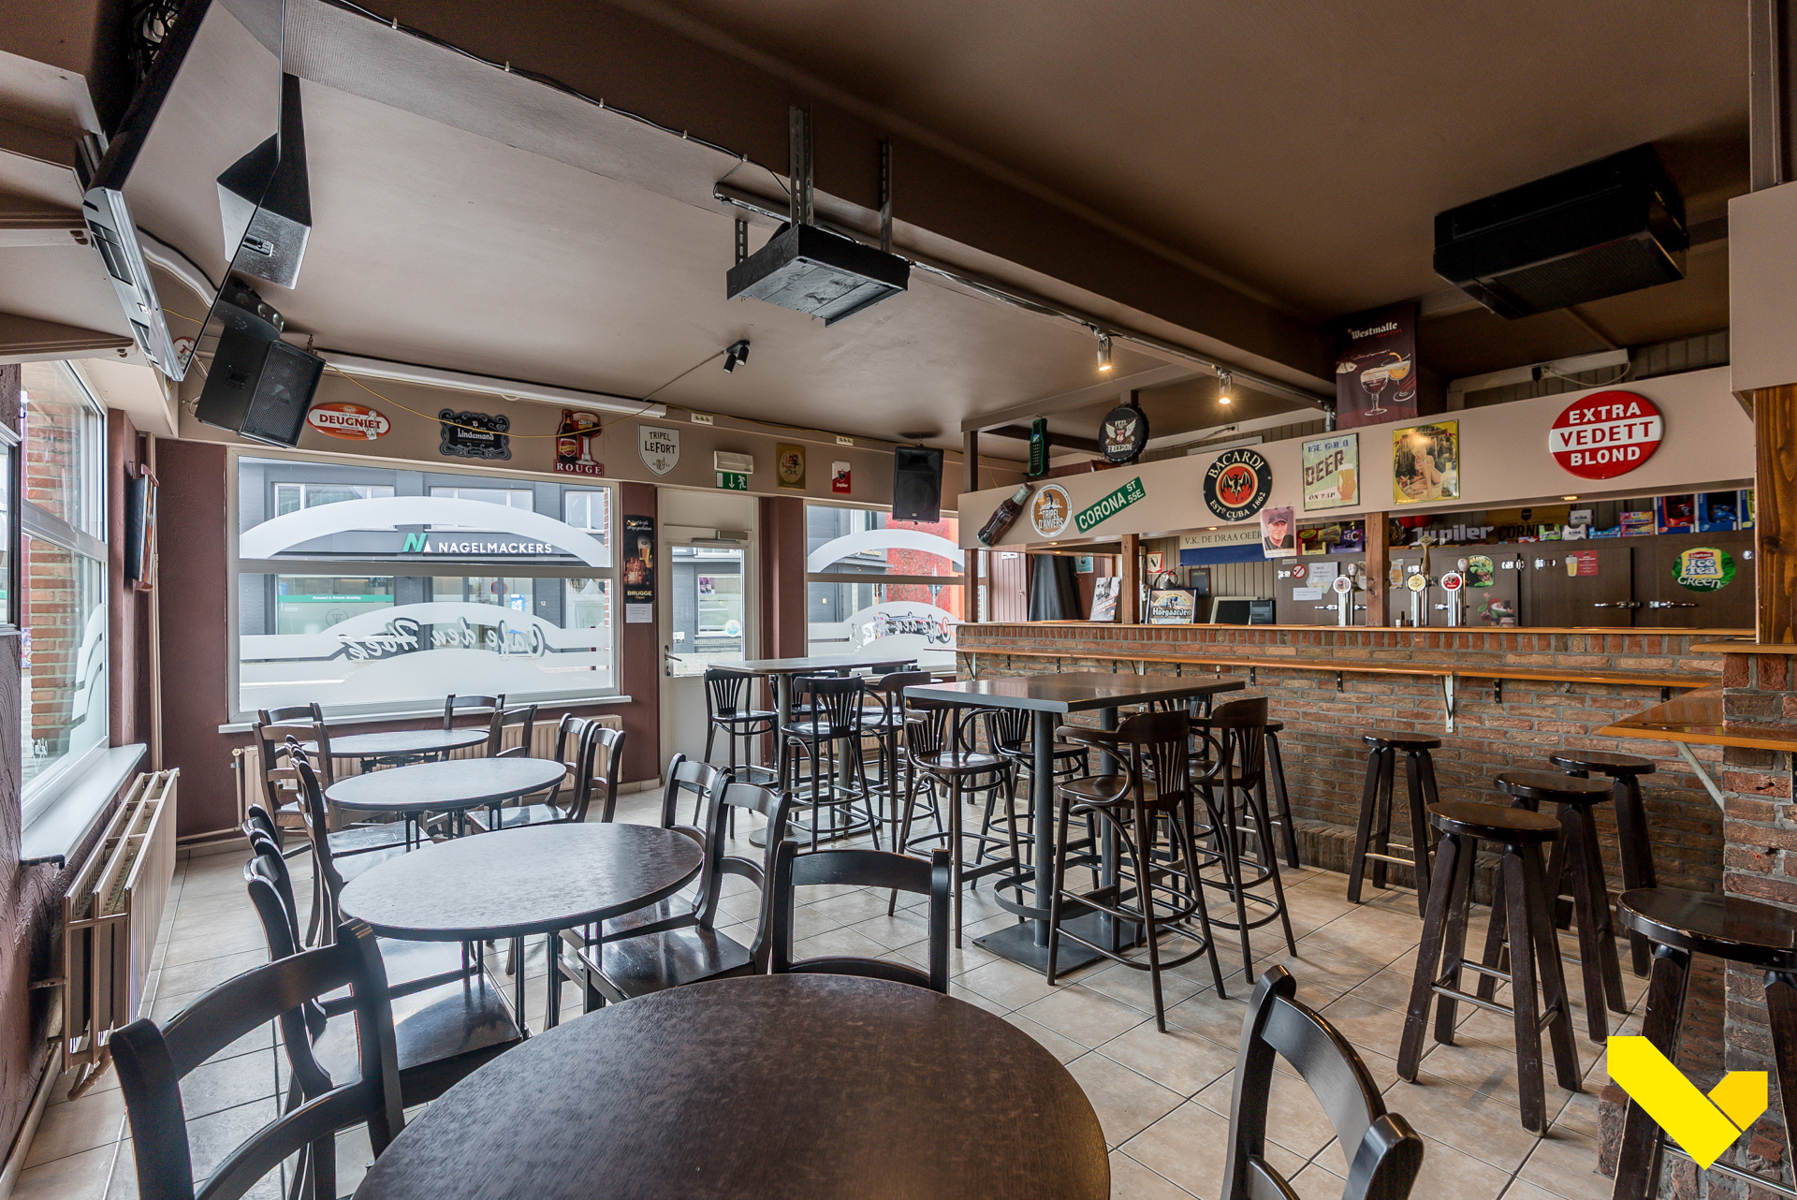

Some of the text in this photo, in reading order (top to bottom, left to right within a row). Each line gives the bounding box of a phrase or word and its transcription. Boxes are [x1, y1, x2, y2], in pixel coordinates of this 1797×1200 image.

[1351, 321, 1398, 340] Westmalle
[1569, 402, 1641, 424] EXTRA
[319, 414, 382, 430] DEUGNIET
[1114, 419, 1128, 427] FEEL
[649, 431, 671, 442] TRIPEL
[1559, 420, 1654, 448] VEDETT
[1107, 443, 1132, 453] FREEDOM
[1570, 446, 1640, 466] BLOND
[556, 462, 602, 475] ROUGE
[1208, 451, 1264, 478] BACARDI
[1305, 449, 1344, 486] BEER
[1321, 491, 1336, 499] TAP
[1079, 492, 1127, 530] CORONA
[1126, 479, 1136, 492] ST
[1226, 509, 1250, 518] CUBA
[1252, 491, 1266, 509] 1862
[1042, 508, 1060, 519] TRIPEL
[1038, 517, 1064, 529] D'ANVERS
[1185, 536, 1199, 544] V.K.
[1201, 535, 1212, 543] DE
[1214, 533, 1239, 542] DRAA
[1409, 523, 1495, 547] Jupiler
[438, 542, 552, 553] NAGELMACKERS
[1687, 559, 1715, 567] Ice
[1686, 566, 1717, 575] Tea
[1152, 606, 1192, 618] Hoegaarden
